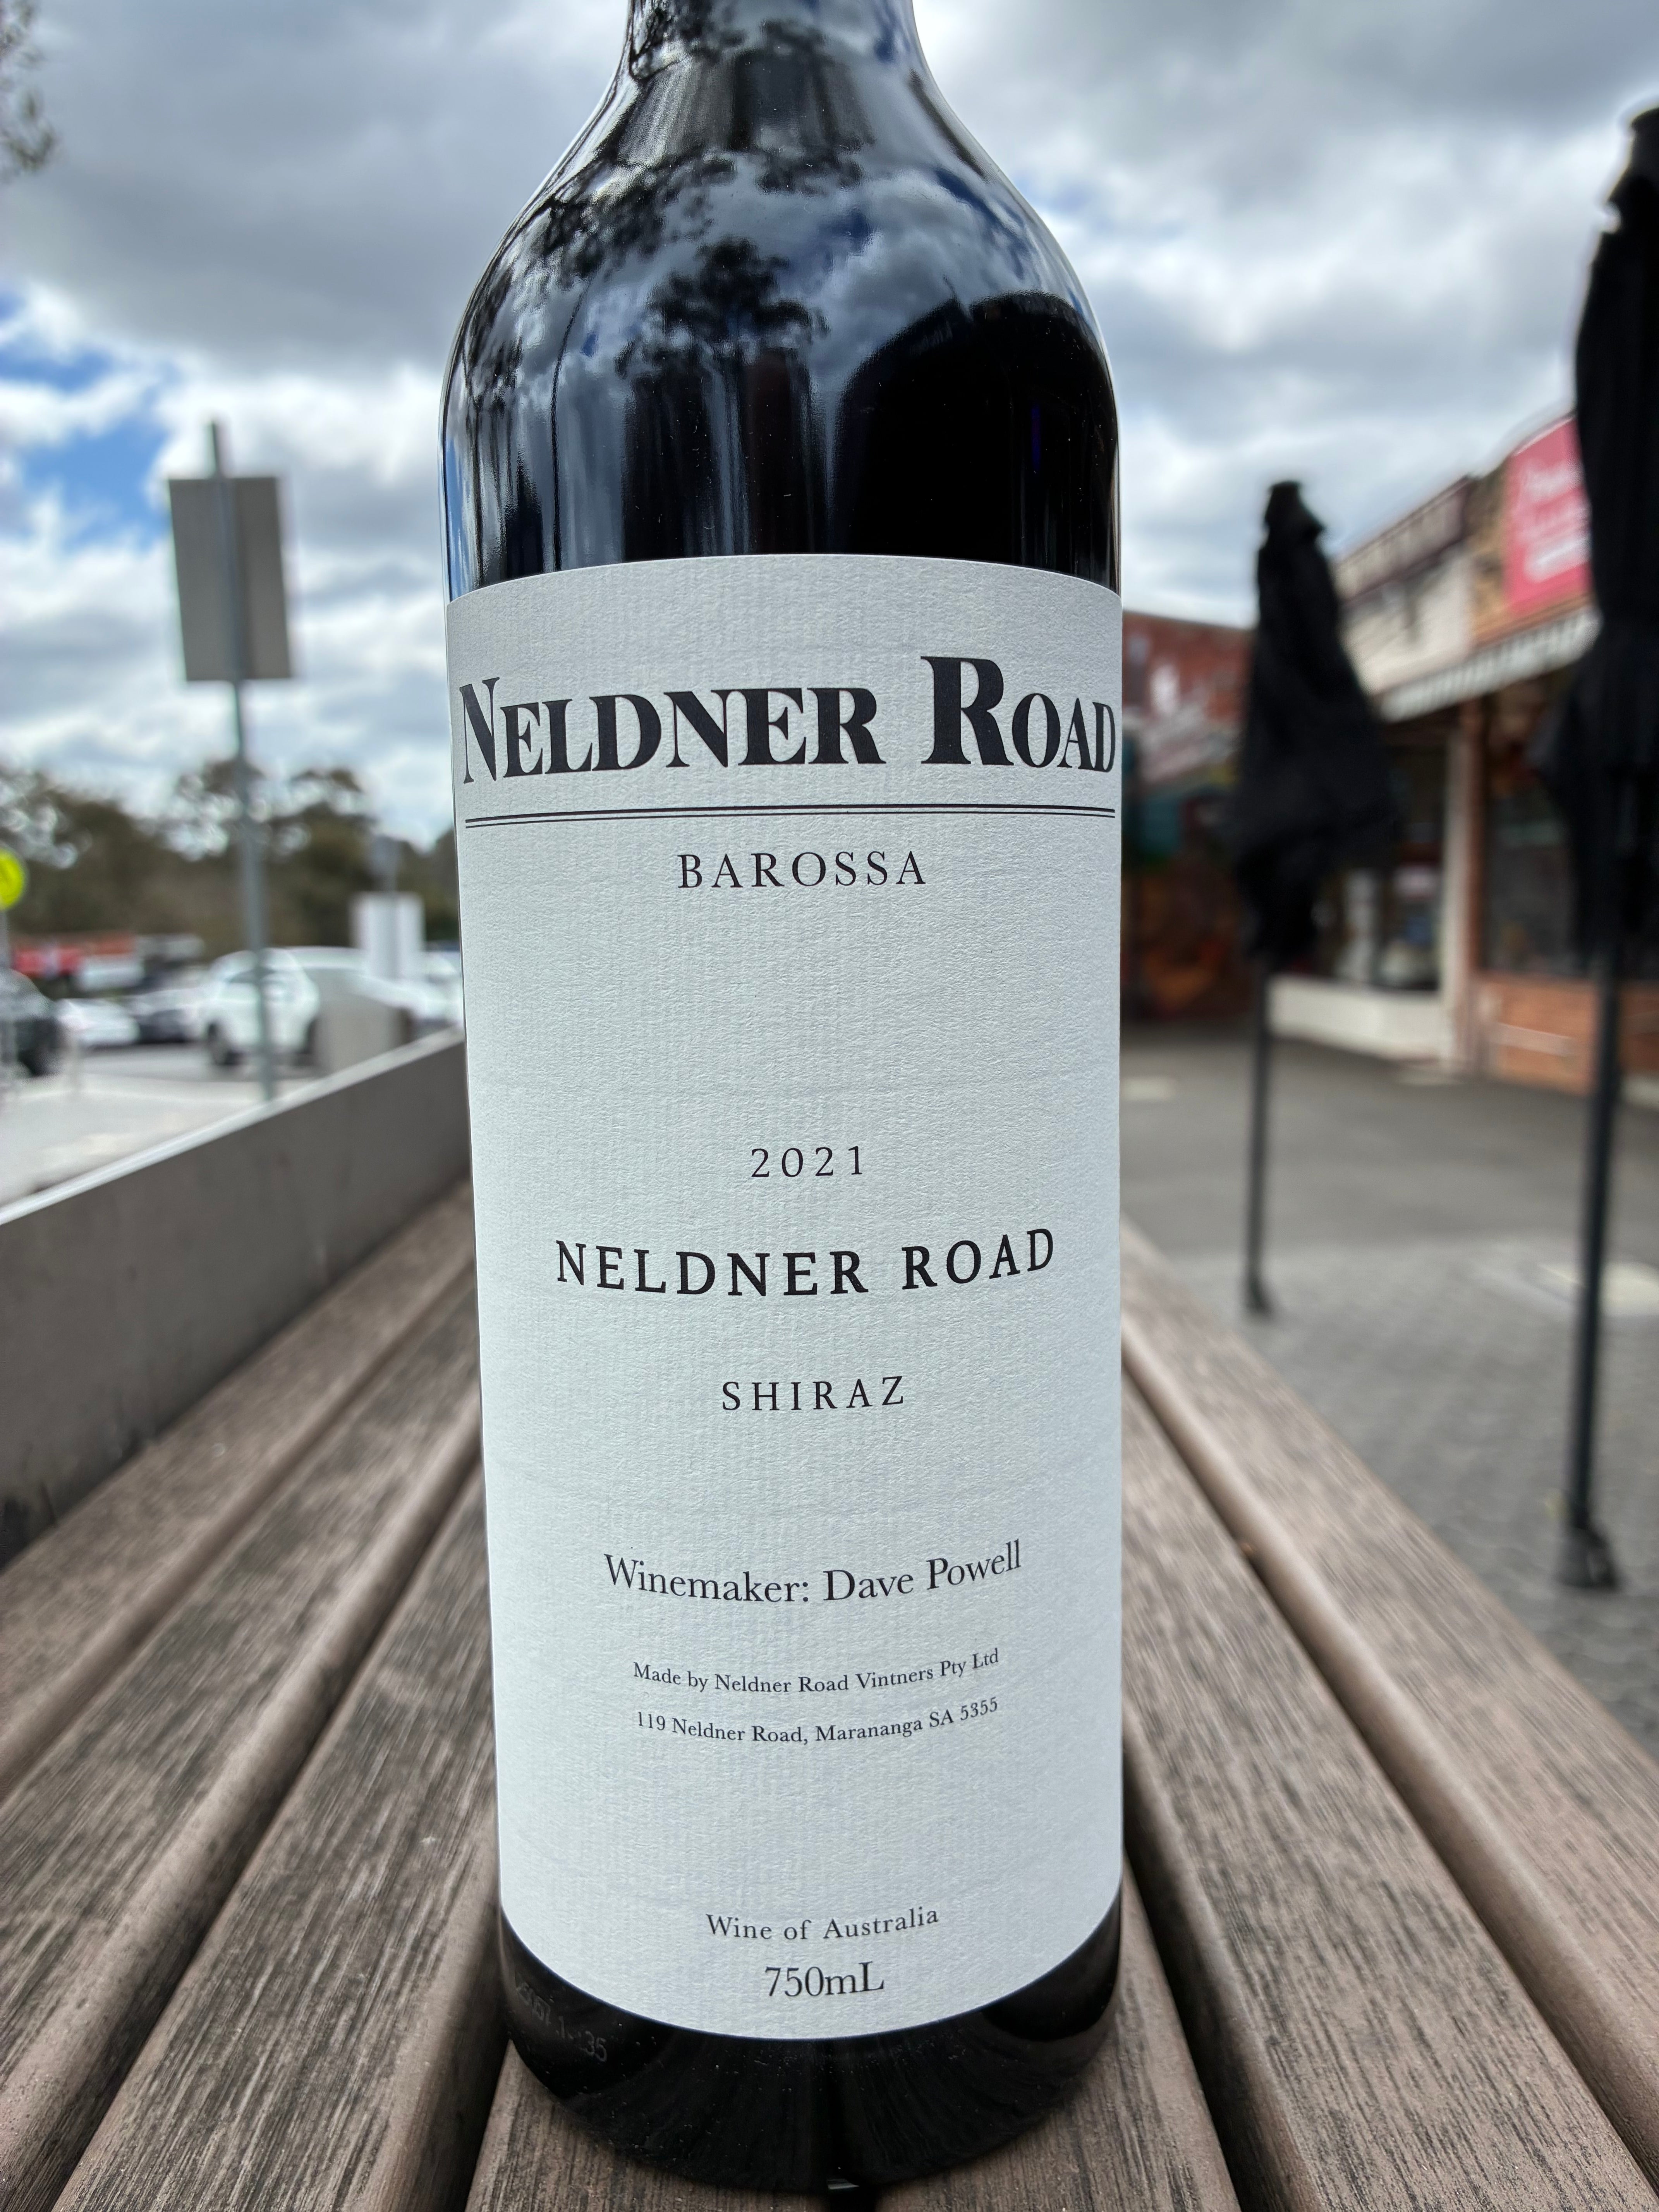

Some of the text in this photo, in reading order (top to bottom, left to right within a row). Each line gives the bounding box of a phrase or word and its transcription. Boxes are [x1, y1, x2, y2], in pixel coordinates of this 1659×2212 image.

[459, 655, 1116, 784] NELDNER ROAD
[677, 850, 926, 888] BAROSSA
[751, 1146, 863, 1178] 2021
[556, 1228, 1053, 1297] NELDNER ROAD
[722, 1376, 903, 1411] SHIRAZ
[603, 1538, 1022, 1602] Winemaker: Dave Powell
[633, 1647, 998, 1693] Made by Neldner Road Vintners Pty Ltd
[637, 1697, 998, 1745] 119 Neldner Road, Marananga SA 5355
[706, 1906, 939, 1940] Wine of Australia
[764, 1961, 884, 1997] 750mL
